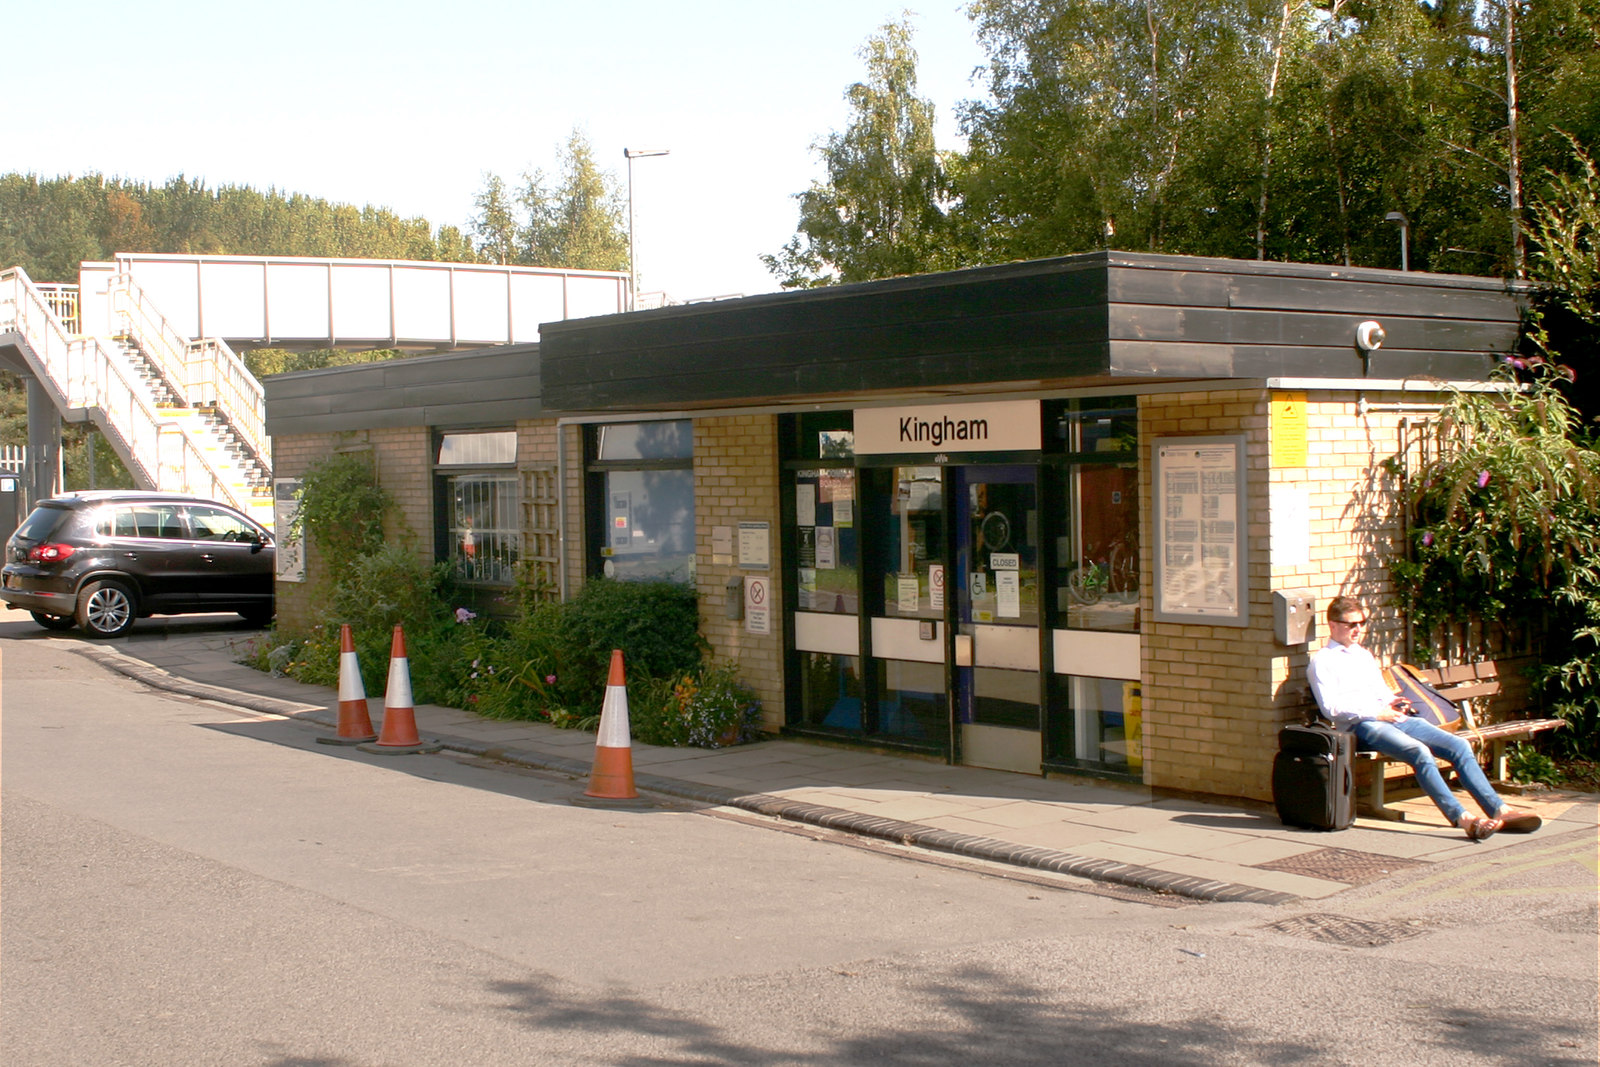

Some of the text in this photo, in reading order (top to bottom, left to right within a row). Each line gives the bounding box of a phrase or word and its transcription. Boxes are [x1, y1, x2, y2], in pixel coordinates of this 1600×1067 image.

[899, 415, 988, 447] Kingham
[797, 469, 825, 478] KINGHA
[992, 558, 1017, 567] CLOSED
